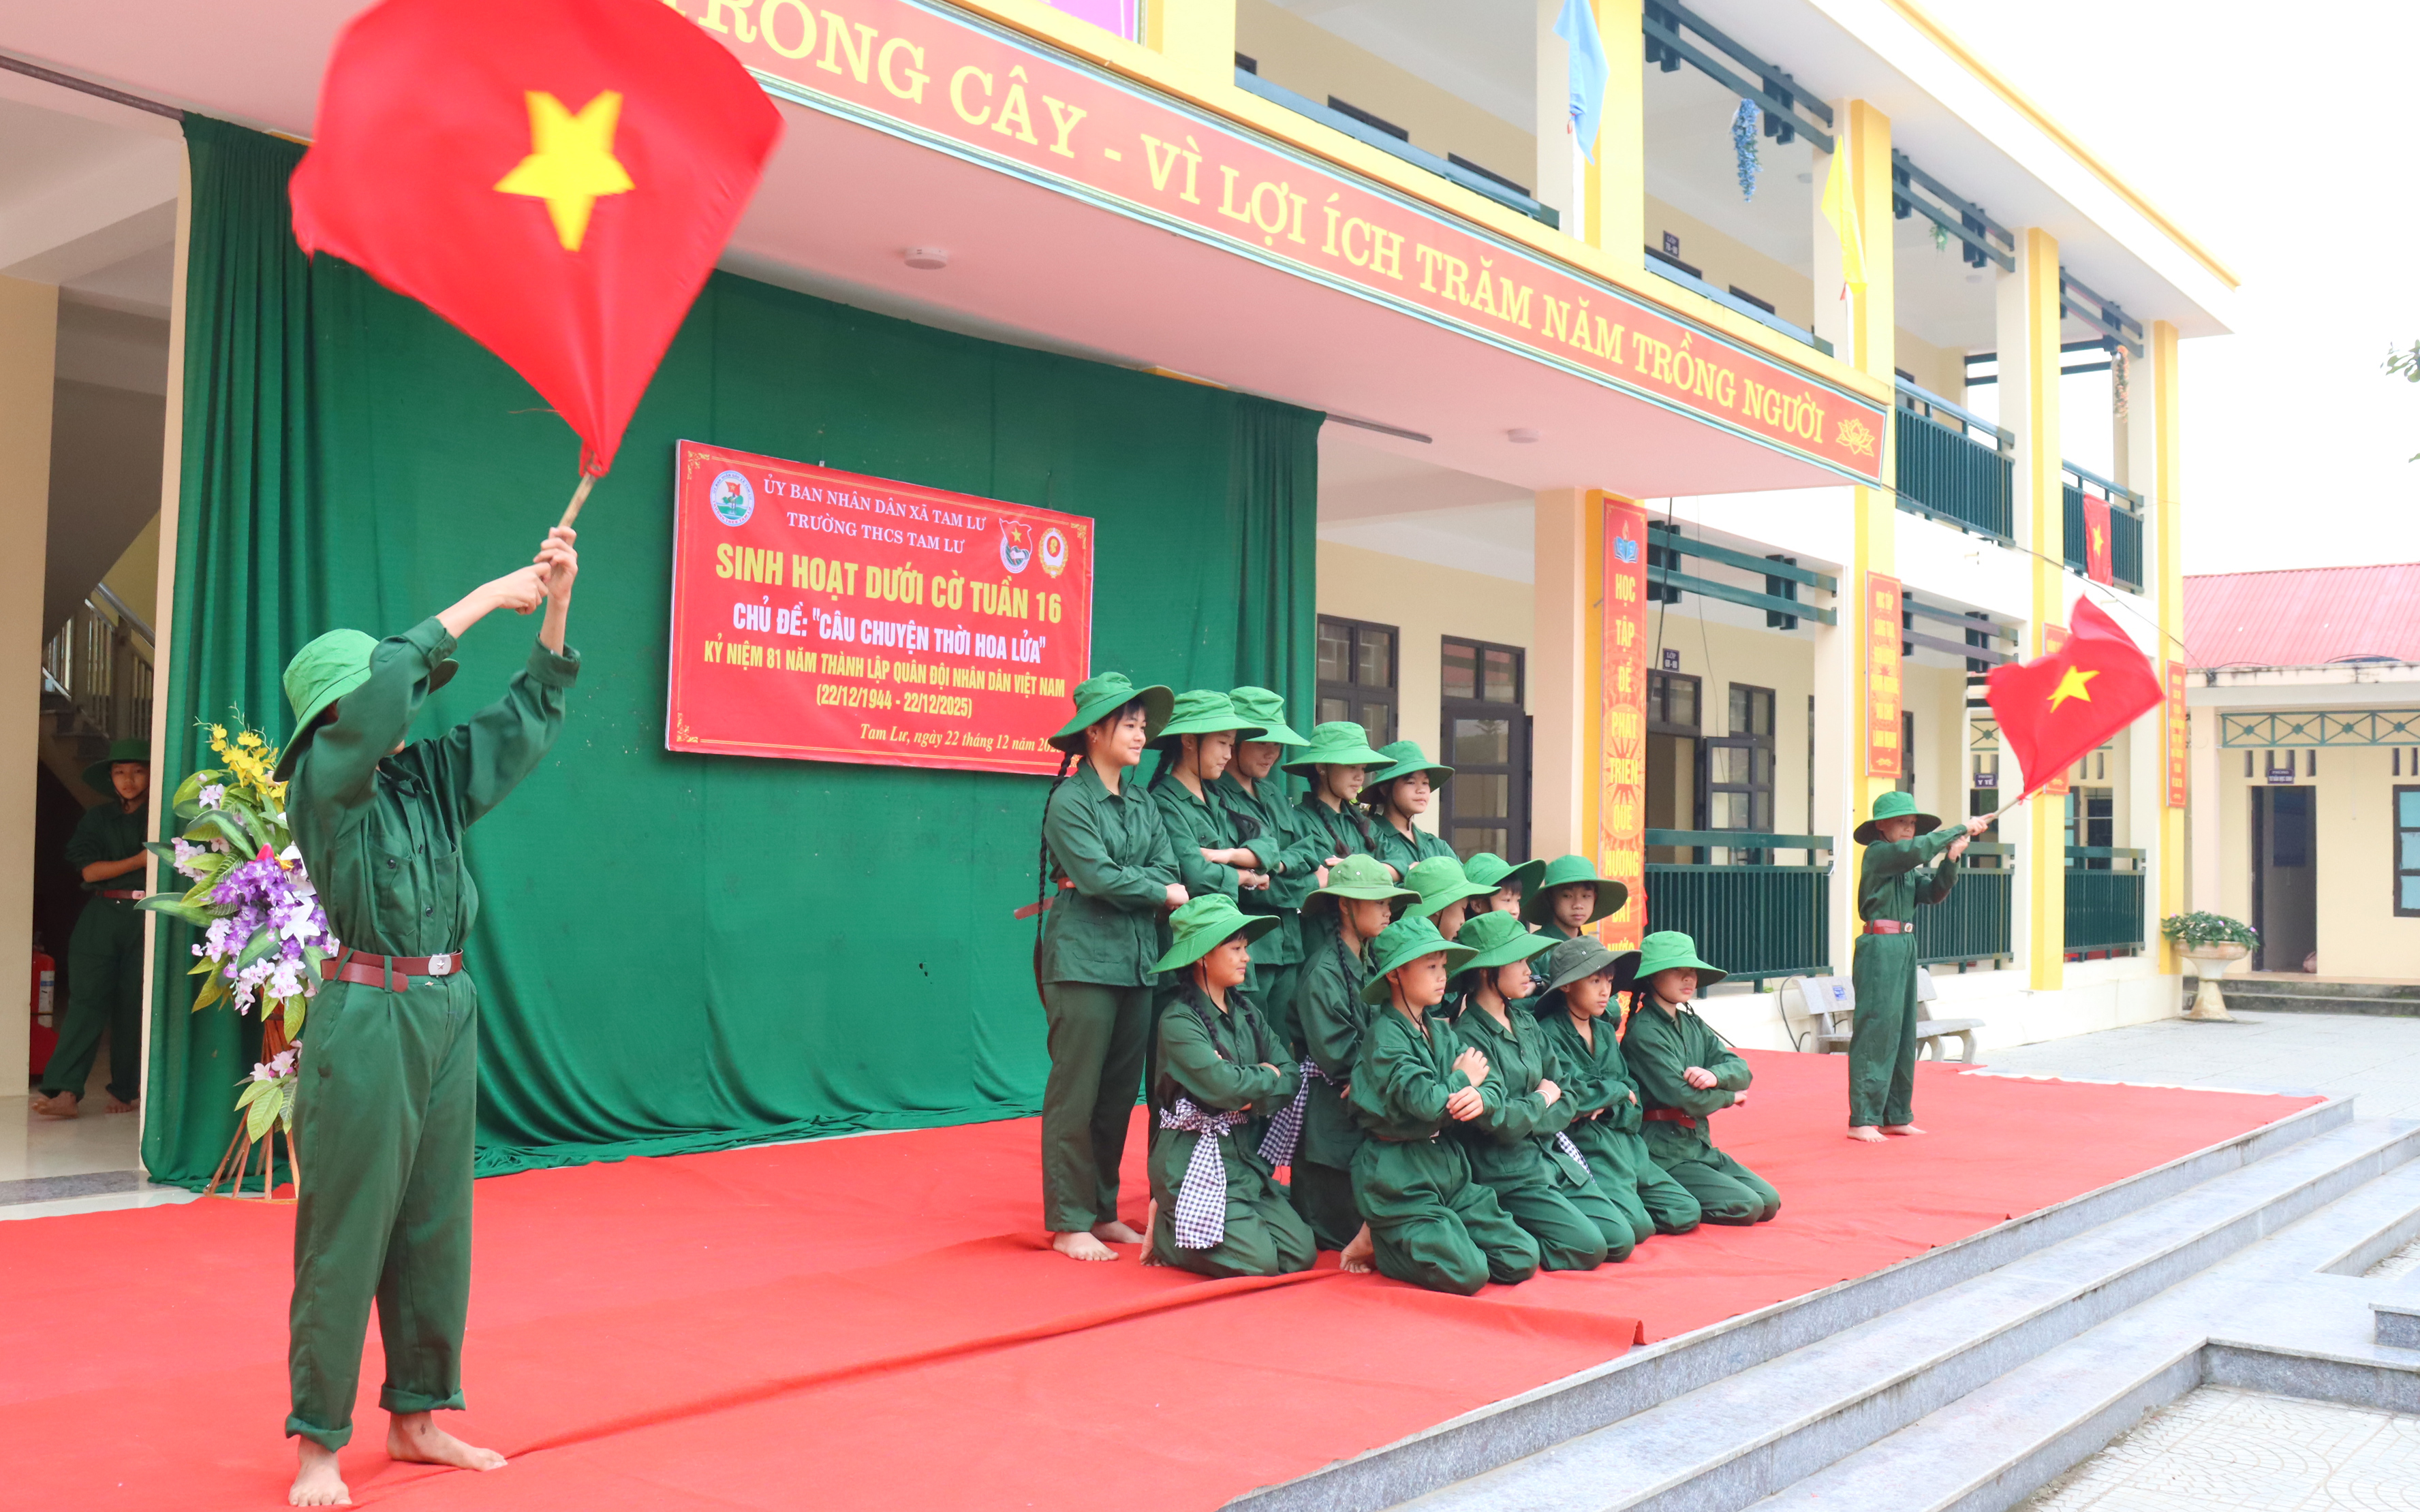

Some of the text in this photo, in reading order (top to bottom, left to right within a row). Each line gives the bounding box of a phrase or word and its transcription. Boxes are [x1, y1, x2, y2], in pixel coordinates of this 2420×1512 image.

[950, 65, 1088, 158] CÂY
[1141, 133, 1202, 204] VÌ
[1218, 165, 1307, 246] LỢI
[1322, 193, 1405, 280] ÍCH
[1416, 243, 1533, 329] TRĂM
[1542, 295, 1624, 364] NĂM
[1633, 331, 1736, 408] TRỒNG
[1742, 379, 1825, 444] NGƯỜI
[764, 474, 987, 531] ỦY BAN NHÂN DÂN XÃ TAM LƯ
[787, 512, 965, 553] TRƯỜNG THCS TAM LƯ
[716, 544, 1061, 623] SINH HOẠT DƯỚI CỜ TUẦN 16
[1615, 573, 1636, 607] HỌC
[734, 595, 771, 632] CHỦ
[776, 601, 807, 636] ĐỀ:
[813, 607, 855, 642] “CÂU
[860, 619, 929, 655] CHUYỆN
[934, 625, 970, 655] THỜI
[975, 633, 1007, 659] HOA
[1615, 615, 1635, 652] TẬP
[704, 632, 1065, 699] KỶ NIỆM 81 NĂM THÀNH LẬP QUÂN ĐỘI NHÂN DÂN VIỆT NAM
[1617, 657, 1632, 693] ĐỂ
[817, 684, 893, 710] (22/12/1944
[903, 692, 973, 719] 22/12/2025)
[860, 723, 1061, 753] Tam Lư, ngày 22 tháng 12 năm 20
[1611, 708, 1638, 739] PHÁT
[1609, 749, 1638, 785] TRIỂN
[1613, 799, 1633, 832] QUÊ
[1605, 847, 1639, 877] HƯƠNG
